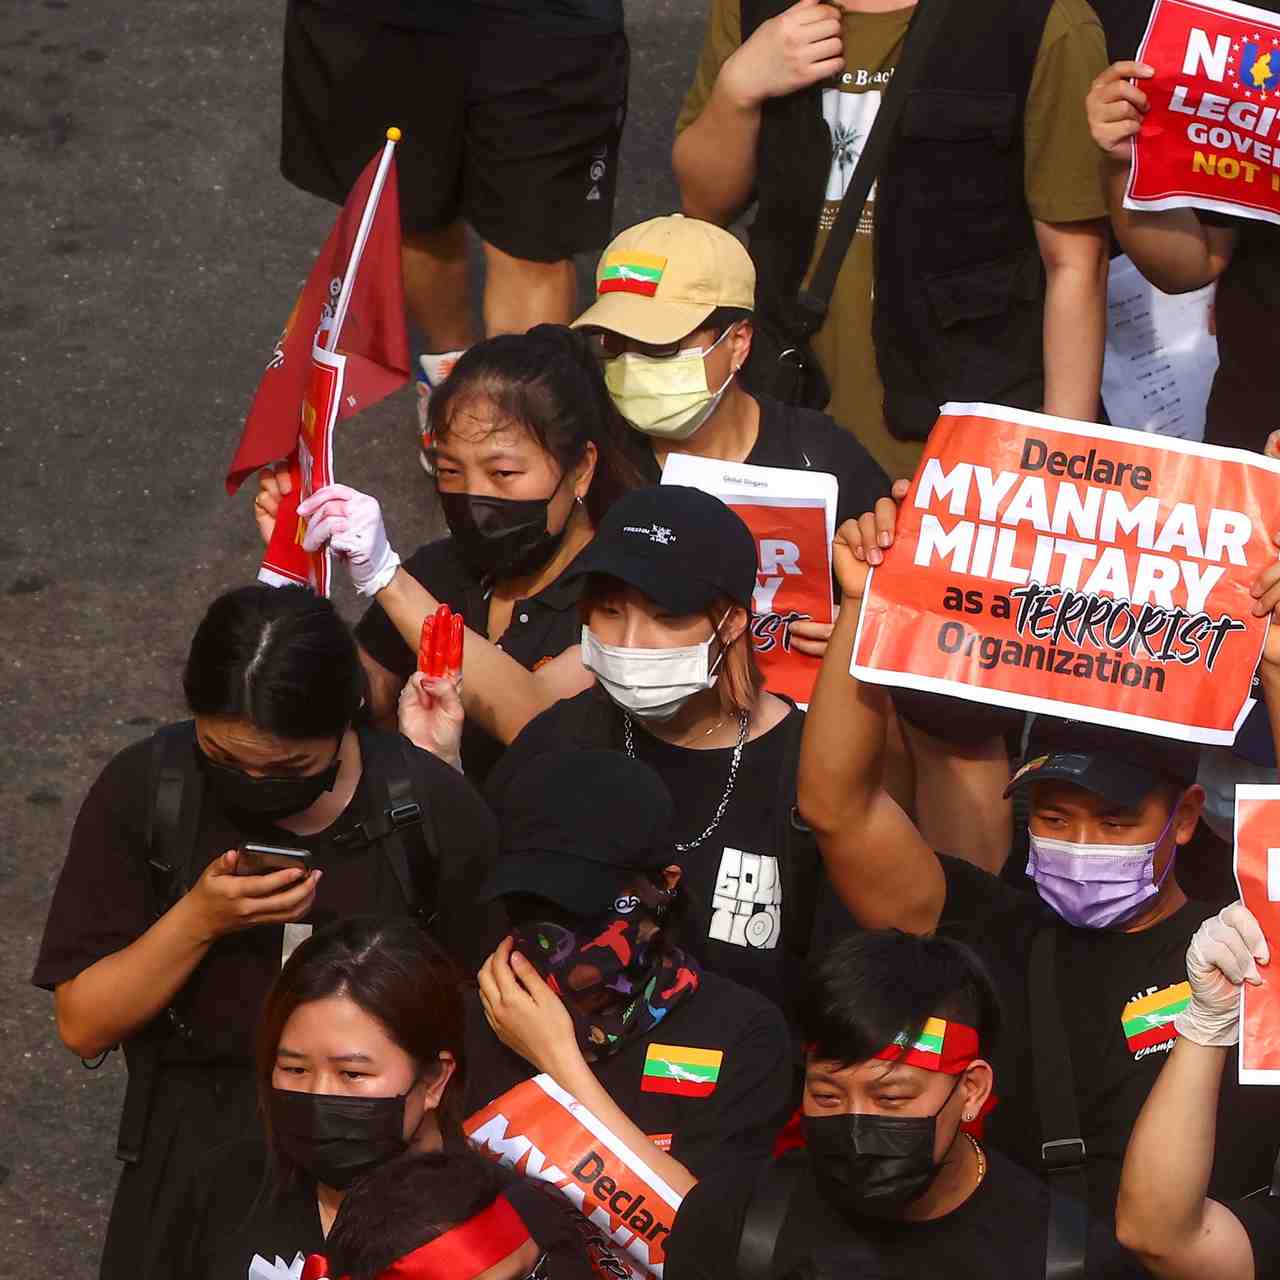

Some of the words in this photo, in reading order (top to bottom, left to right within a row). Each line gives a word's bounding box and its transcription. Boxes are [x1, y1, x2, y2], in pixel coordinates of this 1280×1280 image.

[1191, 150, 1261, 184] NOT
[1020, 438, 1152, 491] Declare
[914, 458, 1252, 565] MYANMAR
[914, 514, 1226, 614] MILITARY
[937, 622, 1165, 693] Organization
[943, 586, 982, 615] as
[990, 592, 1011, 618] a
[1010, 579, 1244, 671] TERRORIST
[572, 1151, 670, 1242] Declar
